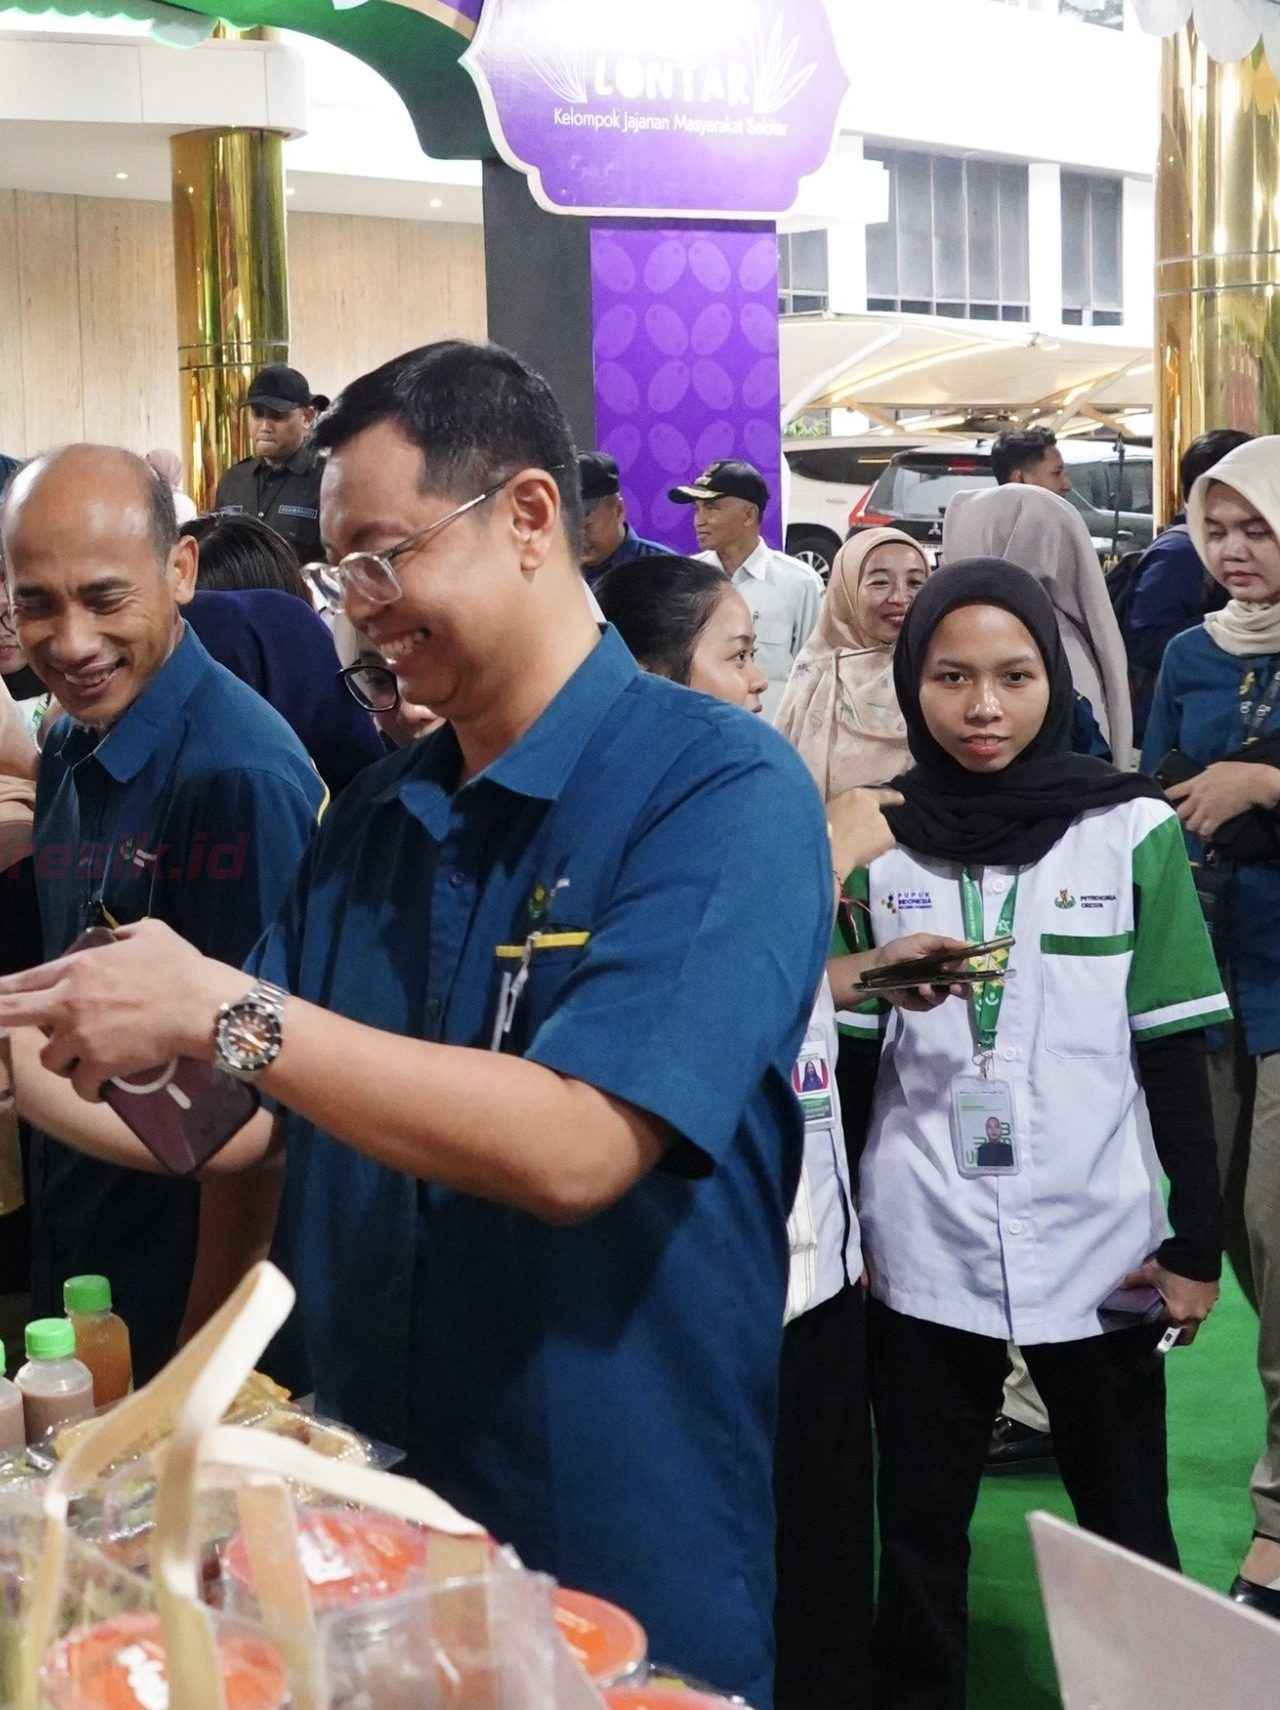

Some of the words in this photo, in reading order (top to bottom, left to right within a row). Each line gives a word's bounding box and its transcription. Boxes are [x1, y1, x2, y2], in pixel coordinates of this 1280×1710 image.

[593, 53, 751, 106] LONTAR
[554, 107, 620, 132] Kelompok
[622, 111, 671, 133] Jajanan
